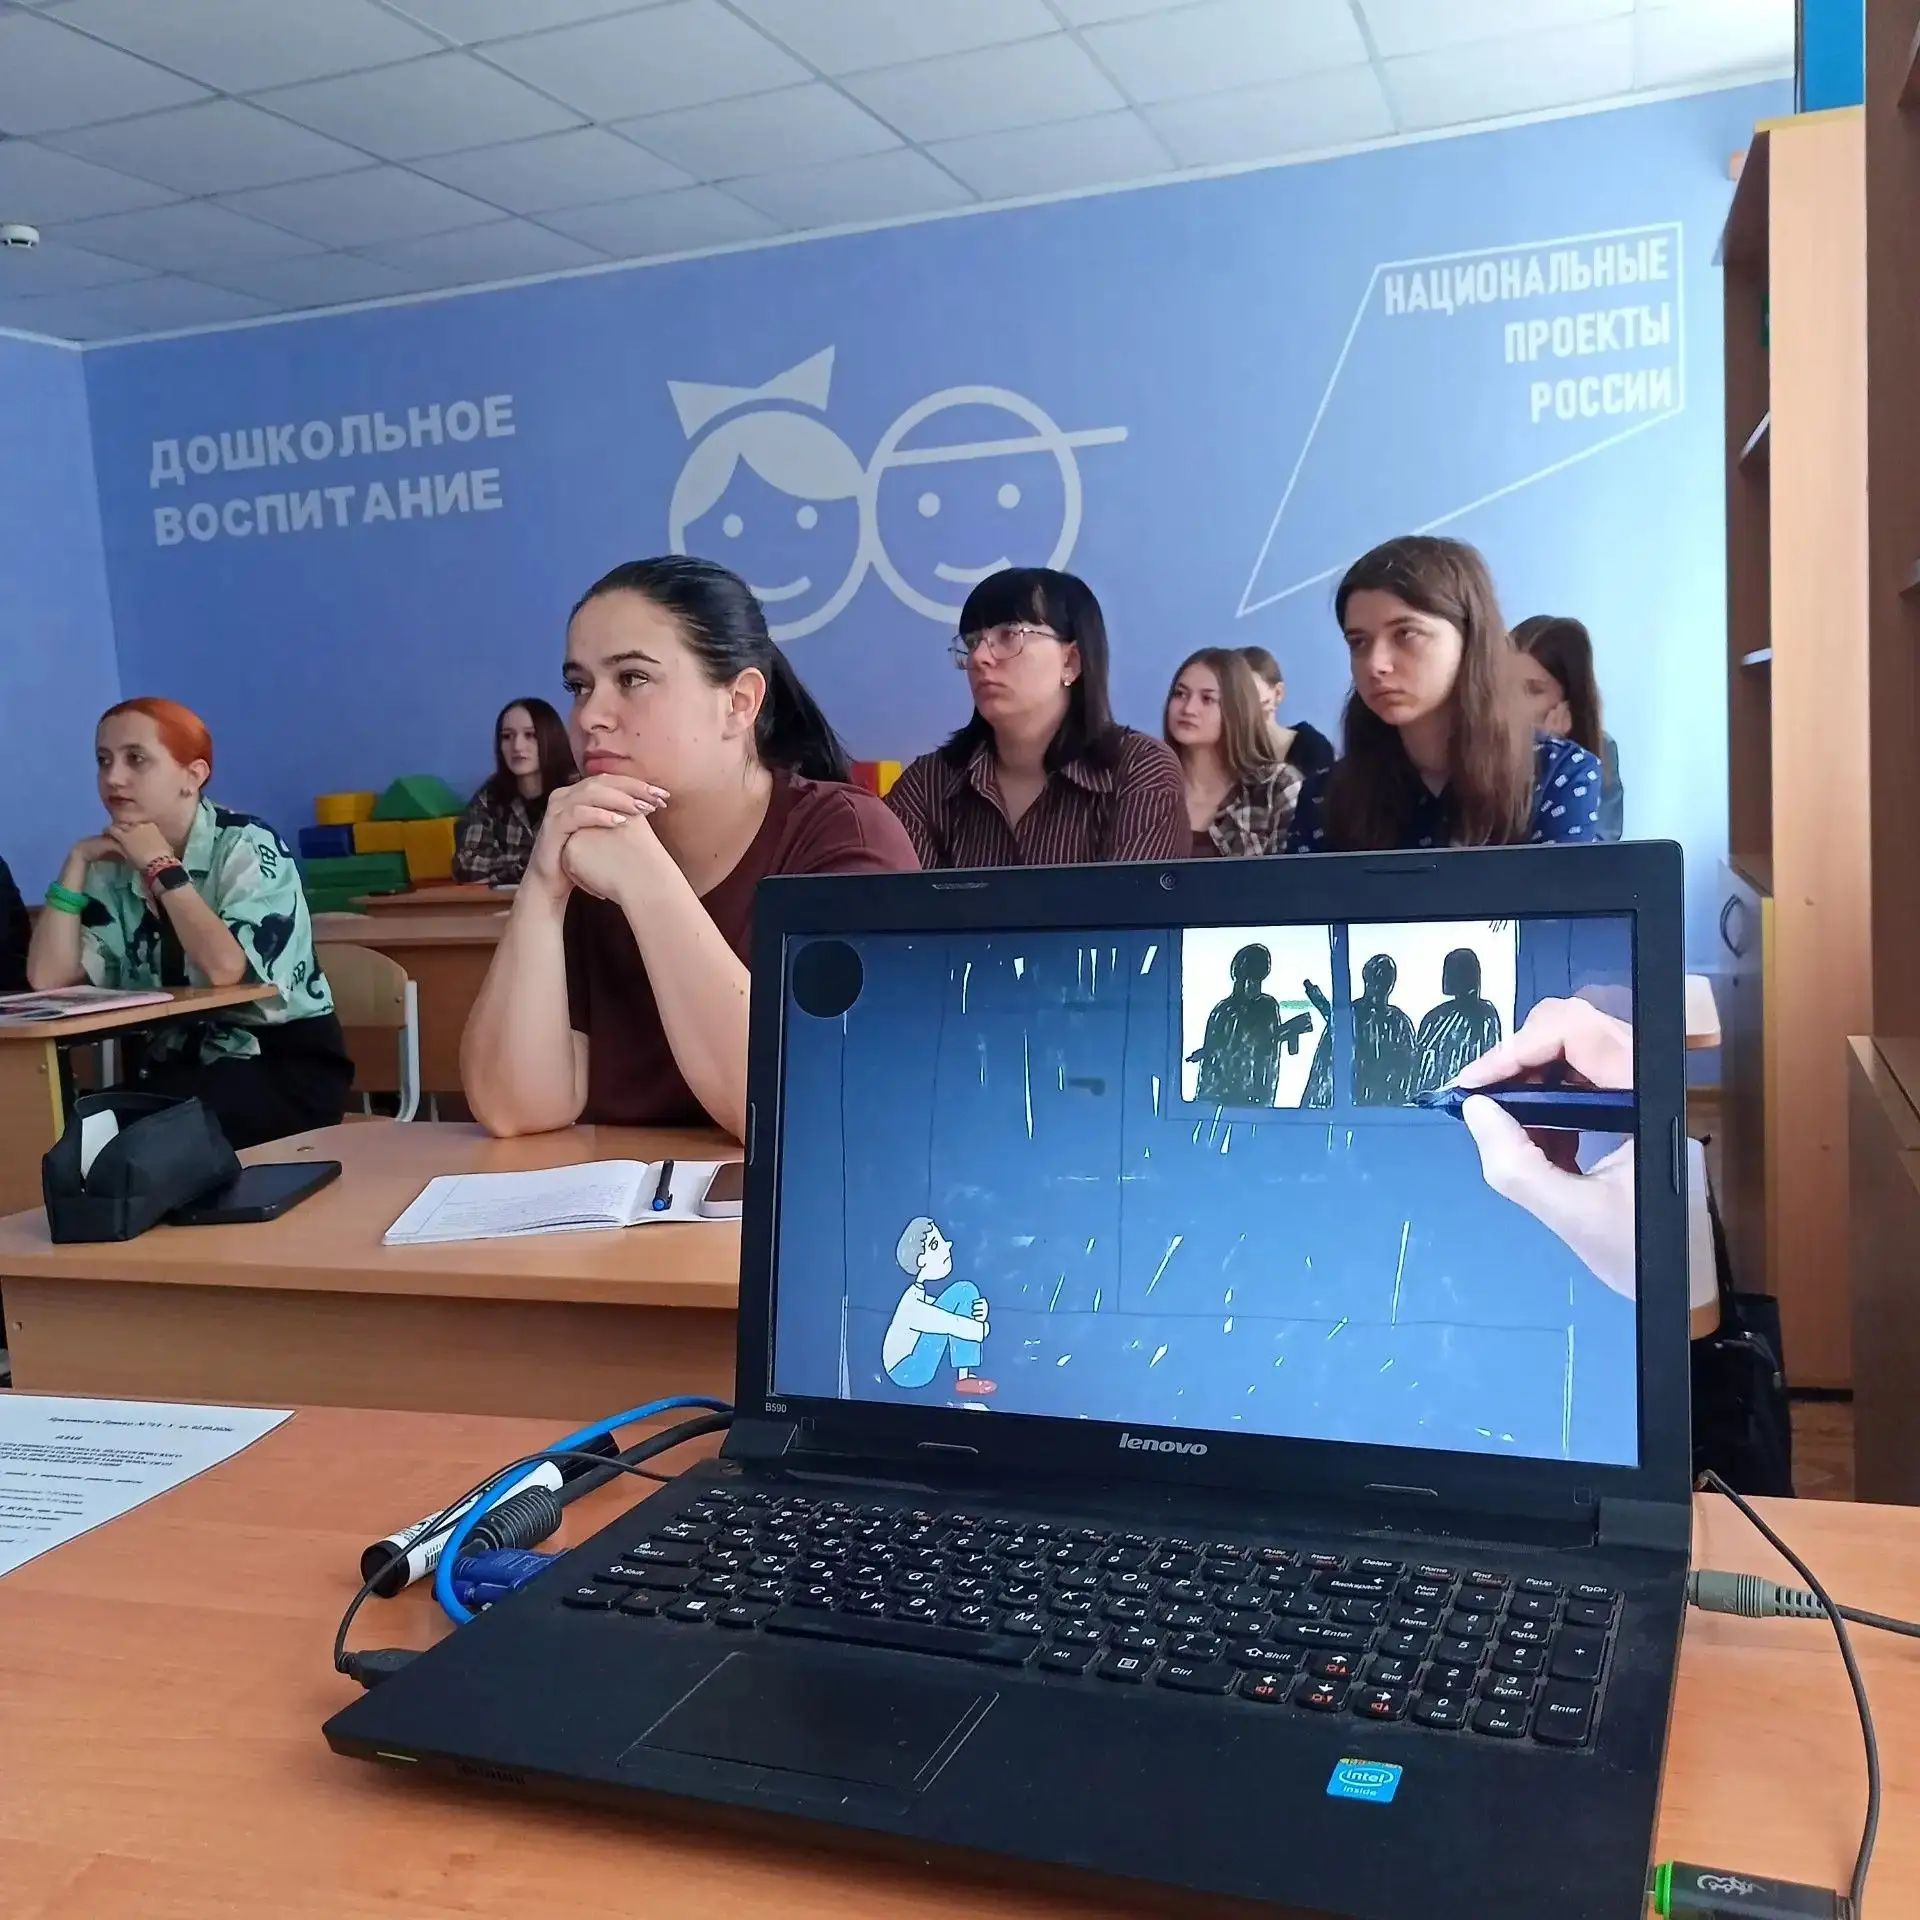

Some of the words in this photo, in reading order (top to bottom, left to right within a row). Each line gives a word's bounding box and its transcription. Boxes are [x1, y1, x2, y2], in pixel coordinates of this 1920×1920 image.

[1384, 236, 1670, 317] НАЦИОНАЛЬНЫЕ
[1504, 302, 1671, 364] ПРОЕКТЫ
[1530, 366, 1672, 424] РОССИИ
[149, 394, 515, 489] ДОШКОЛЬНОЕ
[153, 468, 503, 546] ВОСПИТАНИЕ
[765, 1402, 787, 1413] B590
[1118, 1432, 1208, 1455] lenovo
[733, 1528, 748, 1536] Q
[777, 1533, 797, 1541] W
[823, 1539, 840, 1547] E
[717, 1550, 733, 1559] A
[763, 1555, 778, 1563] S
[969, 1554, 983, 1562] Y
[809, 1560, 826, 1569] D
[1362, 1558, 1393, 1567] Delete
[858, 1566, 876, 1574] F
[1420, 1565, 1448, 1574] Home
[712, 1574, 731, 1583] Z
[908, 1572, 924, 1581] G
[1472, 1571, 1492, 1580] End
[759, 1580, 778, 1588] X
[958, 1578, 976, 1587] H
[1330, 1579, 1383, 1590] Backspace
[1526, 1577, 1553, 1587] PgUp
[809, 1586, 826, 1594] C
[1009, 1585, 1024, 1593] J
[1579, 1584, 1608, 1593] PgDn
[860, 1591, 875, 1600] V
[1061, 1591, 1079, 1600] K
[910, 1598, 926, 1606] B
[962, 1605, 981, 1614] N
[1014, 1612, 1035, 1622] M
[1399, 1617, 1428, 1626] Home
[1322, 1629, 1353, 1639] Enter
[1510, 1630, 1538, 1640] PgUp
[1458, 1641, 1469, 1649] 5
[1053, 1650, 1071, 1659] Alt
[1264, 1651, 1291, 1661] Shift
[1515, 1648, 1526, 1656] 6
[1170, 1667, 1193, 1676] Ctrl
[1448, 1668, 1460, 1677] 2
[1381, 1672, 1402, 1681] End
[1506, 1676, 1518, 1684] 3
[1494, 1686, 1523, 1696] PgDn
[1550, 1703, 1582, 1714] Enter
[1430, 1710, 1447, 1719] Ins
[1489, 1719, 1510, 1728] Del
[1346, 1769, 1385, 1784] intel
[1342, 1785, 1378, 1797] inside
